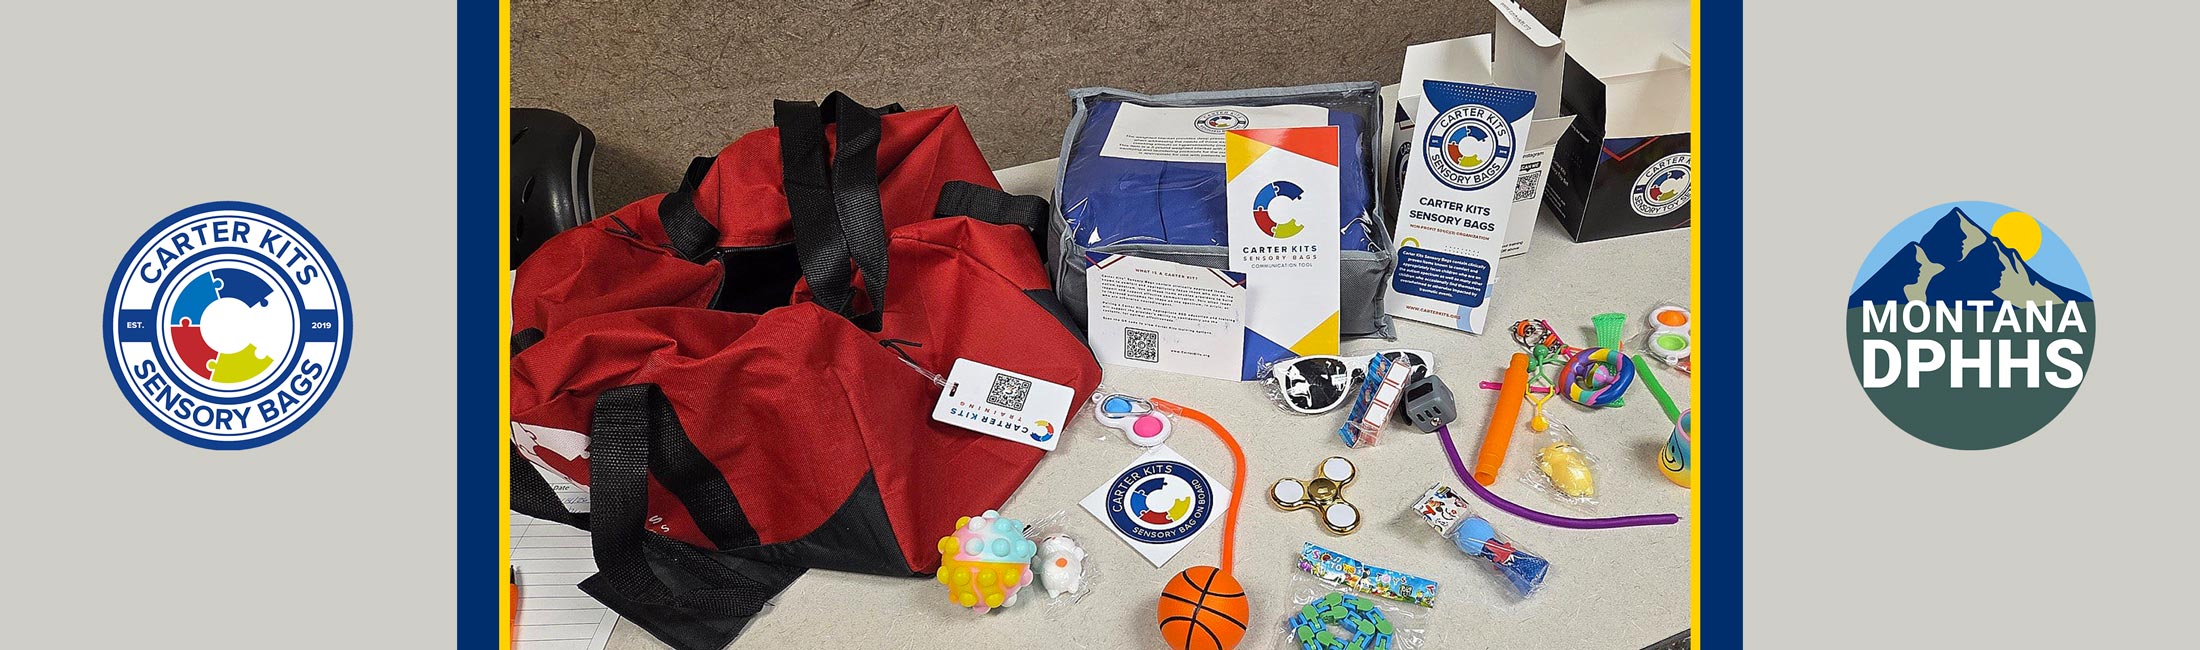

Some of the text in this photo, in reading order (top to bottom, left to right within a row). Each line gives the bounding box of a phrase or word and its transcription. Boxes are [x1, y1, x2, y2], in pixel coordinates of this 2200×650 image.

[1440, 108, 1506, 136] CARTER KITS
[1432, 154, 1500, 184] SENSORY BAGS
[1646, 157, 1684, 177] CARTER
[1420, 197, 1491, 216] CARTER KITS
[1663, 201, 1679, 211] TOY
[1409, 210, 1495, 231] SENSORY BAGS
[950, 407, 1028, 434] CARTER KITS
[960, 401, 1022, 422] TRAINING
[1113, 465, 1173, 512] CARTER KITS
[1132, 479, 1206, 538] SENSORY BAG ON BOARD
